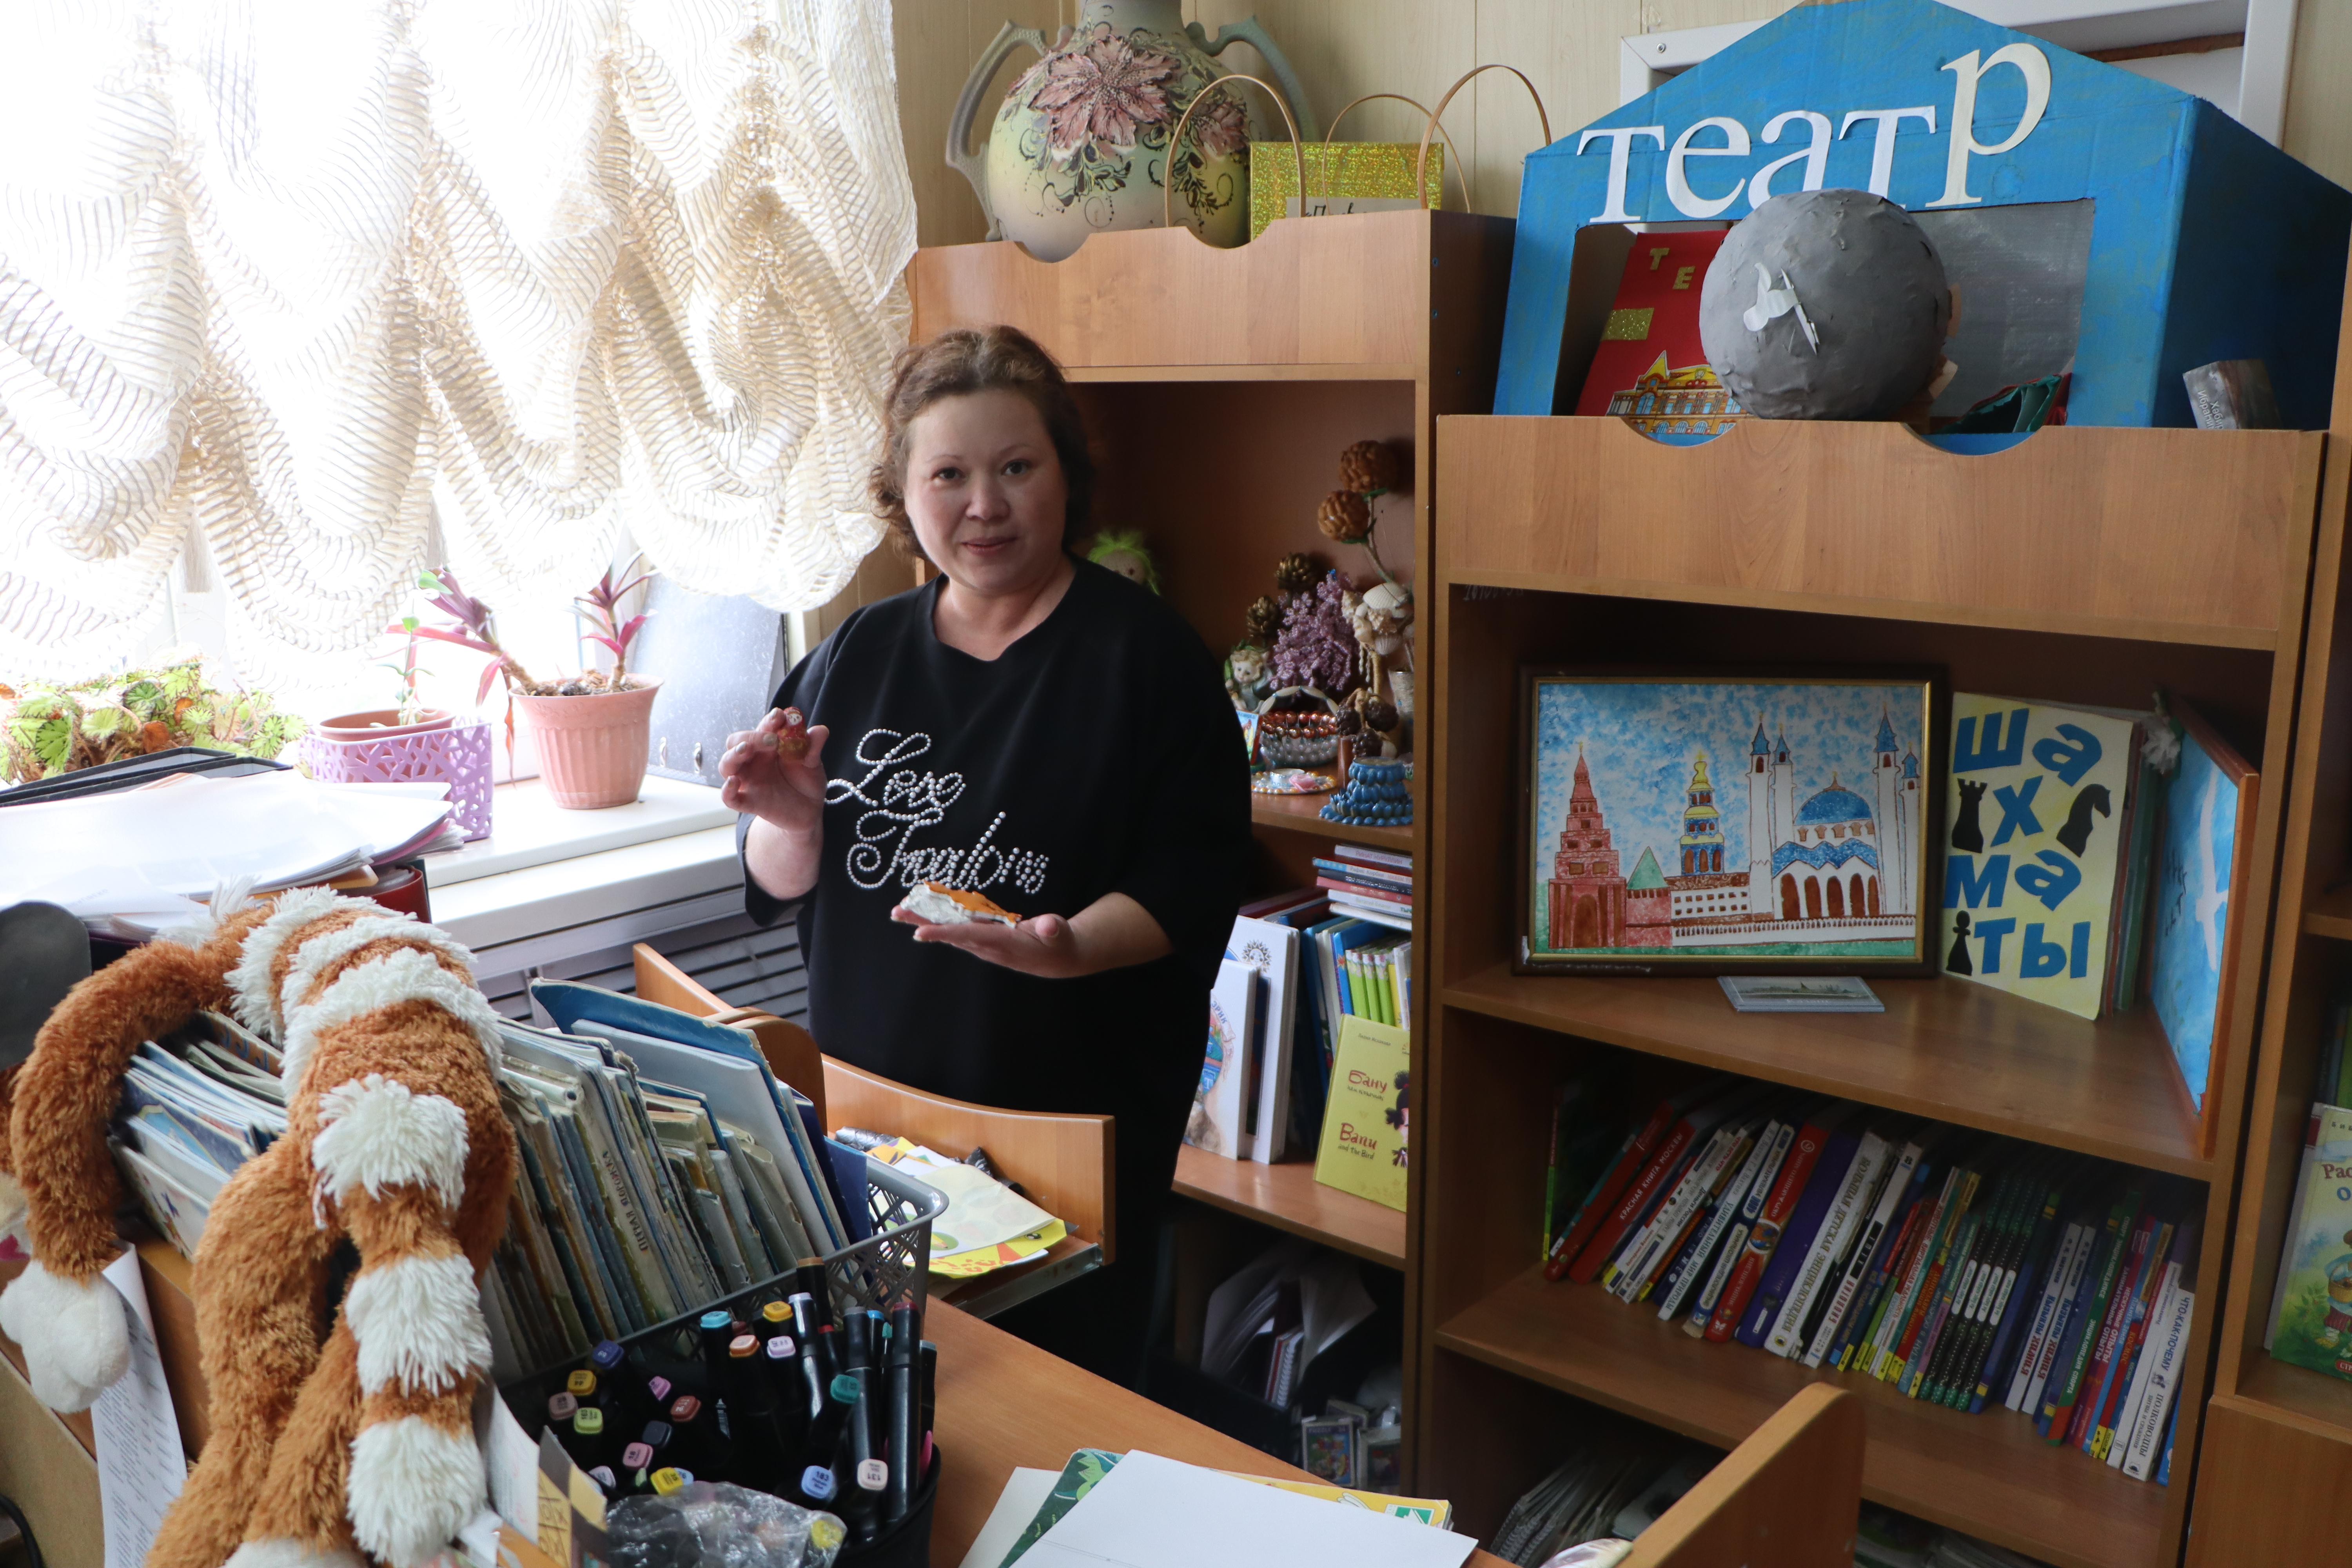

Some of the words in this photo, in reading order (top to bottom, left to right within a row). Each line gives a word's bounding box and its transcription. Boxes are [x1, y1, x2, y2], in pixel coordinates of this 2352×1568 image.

[1577, 42, 2051, 223] театр
[1348, 1070, 1388, 1094] Бану
[1338, 1143, 1350, 1152] and
[1361, 1149, 1375, 1160] Bird
[1722, 1145, 1734, 1160] ЕСТЬ
[1731, 1135, 1741, 1147] ЧТО
[1618, 1187, 1645, 1221] КРАСНАЯ
[1641, 1163, 1662, 1189] КНИГА
[1658, 1131, 1684, 1165] МОСКВЫ
[1714, 1159, 1725, 1172] ЧТО
[1755, 1149, 1781, 1197] УВЛЕКАТЕЛЬНЫХ
[1770, 1169, 1797, 1218] ОКРУЖАЮЩЕГО
[1793, 1151, 1806, 1170] МИРА
[1840, 1156, 1871, 1208] БОЛЬШАЯ
[1688, 1186, 1707, 1209] Деньги
[1675, 1207, 1693, 1229] России
[1696, 1200, 1734, 1259] УДИВИТЕЛЬНЫЙ
[1819, 1205, 1848, 1252] ДЕТСКАЯ
[2119, 1215, 2130, 1238] СПОРТ
[1685, 1259, 1700, 1278] МИР
[1702, 1262, 1728, 1307] ЭНЦИКЛОПЕДИЯ
[1723, 1228, 1744, 1264] ШКОЛЬНИКА
[1726, 1256, 1755, 1307] ЭНЦИКЛОПЕДИЯ
[1907, 1242, 1929, 1284] ВИРТУАЛЬНАЯ
[2098, 1238, 2123, 1298] ЭНЦИКЛОПЕДИЯСЕ
[1664, 1275, 1690, 1311] ПРИРОДЫ
[1780, 1251, 1827, 1333] ЭНЦИКЛОПЕДИЯ
[1828, 1279, 1855, 1324] БИОЛОГИЯ
[1867, 1286, 1880, 1306] ЧЕЛОВЕК
[1893, 1284, 1912, 1319] РЕАЛЬНОСТЬ
[1918, 1271, 1940, 1317] ДИНОЗАВРЫ
[2105, 1265, 2130, 1325] ЗАНИМАТЕЛЬНЫЕ
[2112, 1286, 2131, 1328] НЕСКУЧНЫЕ
[1900, 1338, 1923, 1384] ТАТАРСТАН
[2074, 1318, 2096, 1370] ЭНЦИКЛОПЕДИЯ
[2094, 1325, 2111, 1360] ОПЫТЫ
[2102, 1328, 2118, 1363] ОПЫТЫ
[2120, 1331, 2137, 1365] КОСМОС
[2066, 1370, 2079, 1394] СПОРТА
[2124, 1361, 2135, 1382] КОСМОС
[2143, 1394, 2153, 1413] БИТВЫ
[2138, 1393, 2164, 1457] ПОЛКОВОДЦЫ
[816, 1471, 829, 1481] 183
